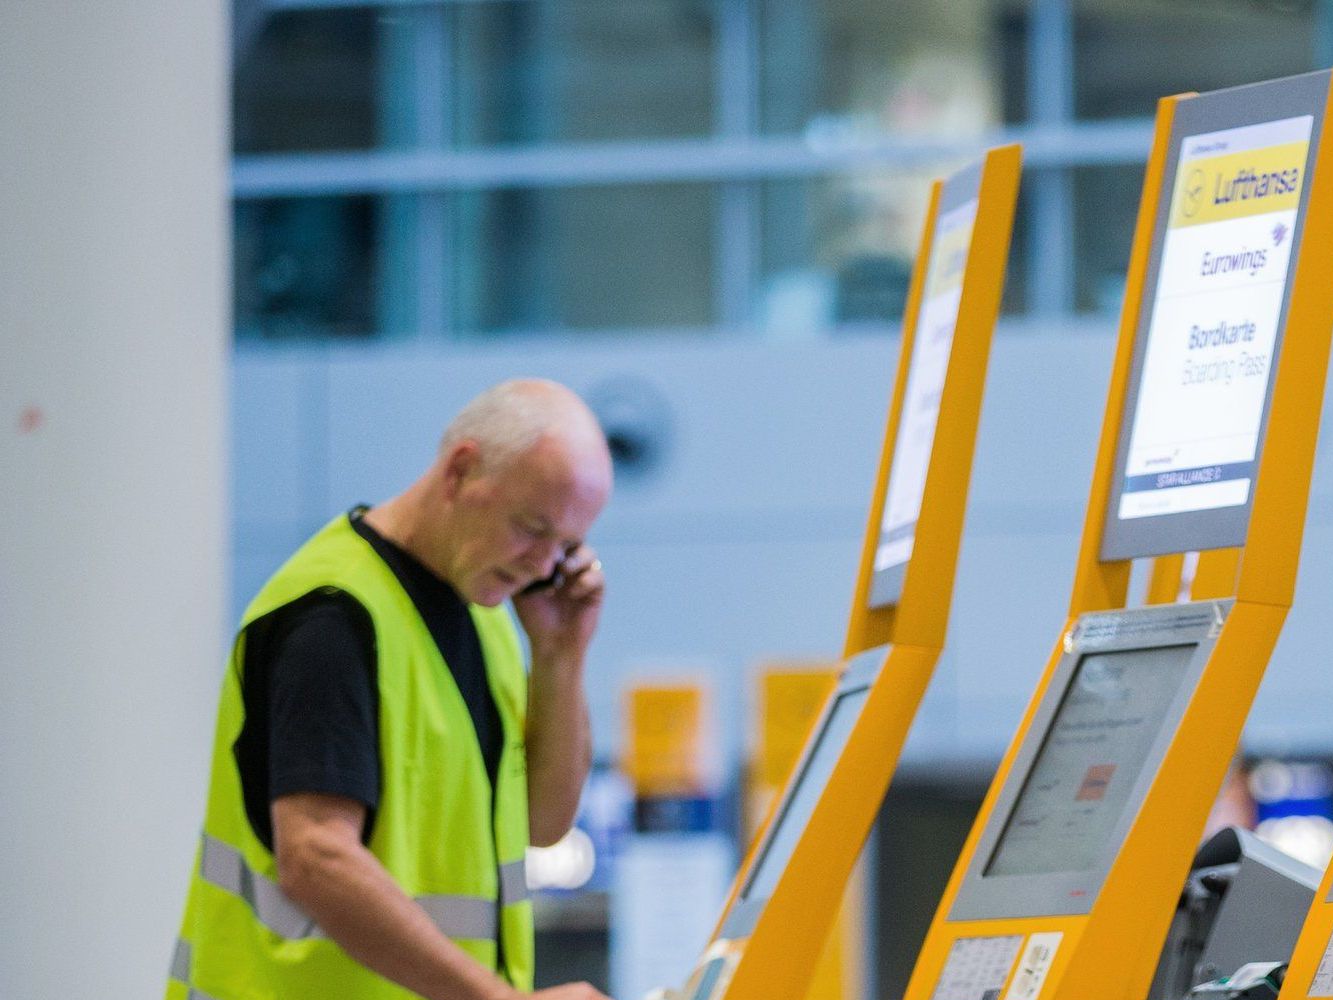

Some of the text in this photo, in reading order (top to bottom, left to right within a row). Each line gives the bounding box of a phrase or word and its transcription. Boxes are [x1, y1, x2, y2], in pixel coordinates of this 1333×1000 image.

[1214, 168, 1298, 204] Lufthansa
[1201, 247, 1267, 276] Eurowings
[1188, 321, 1256, 350] Bordkarte
